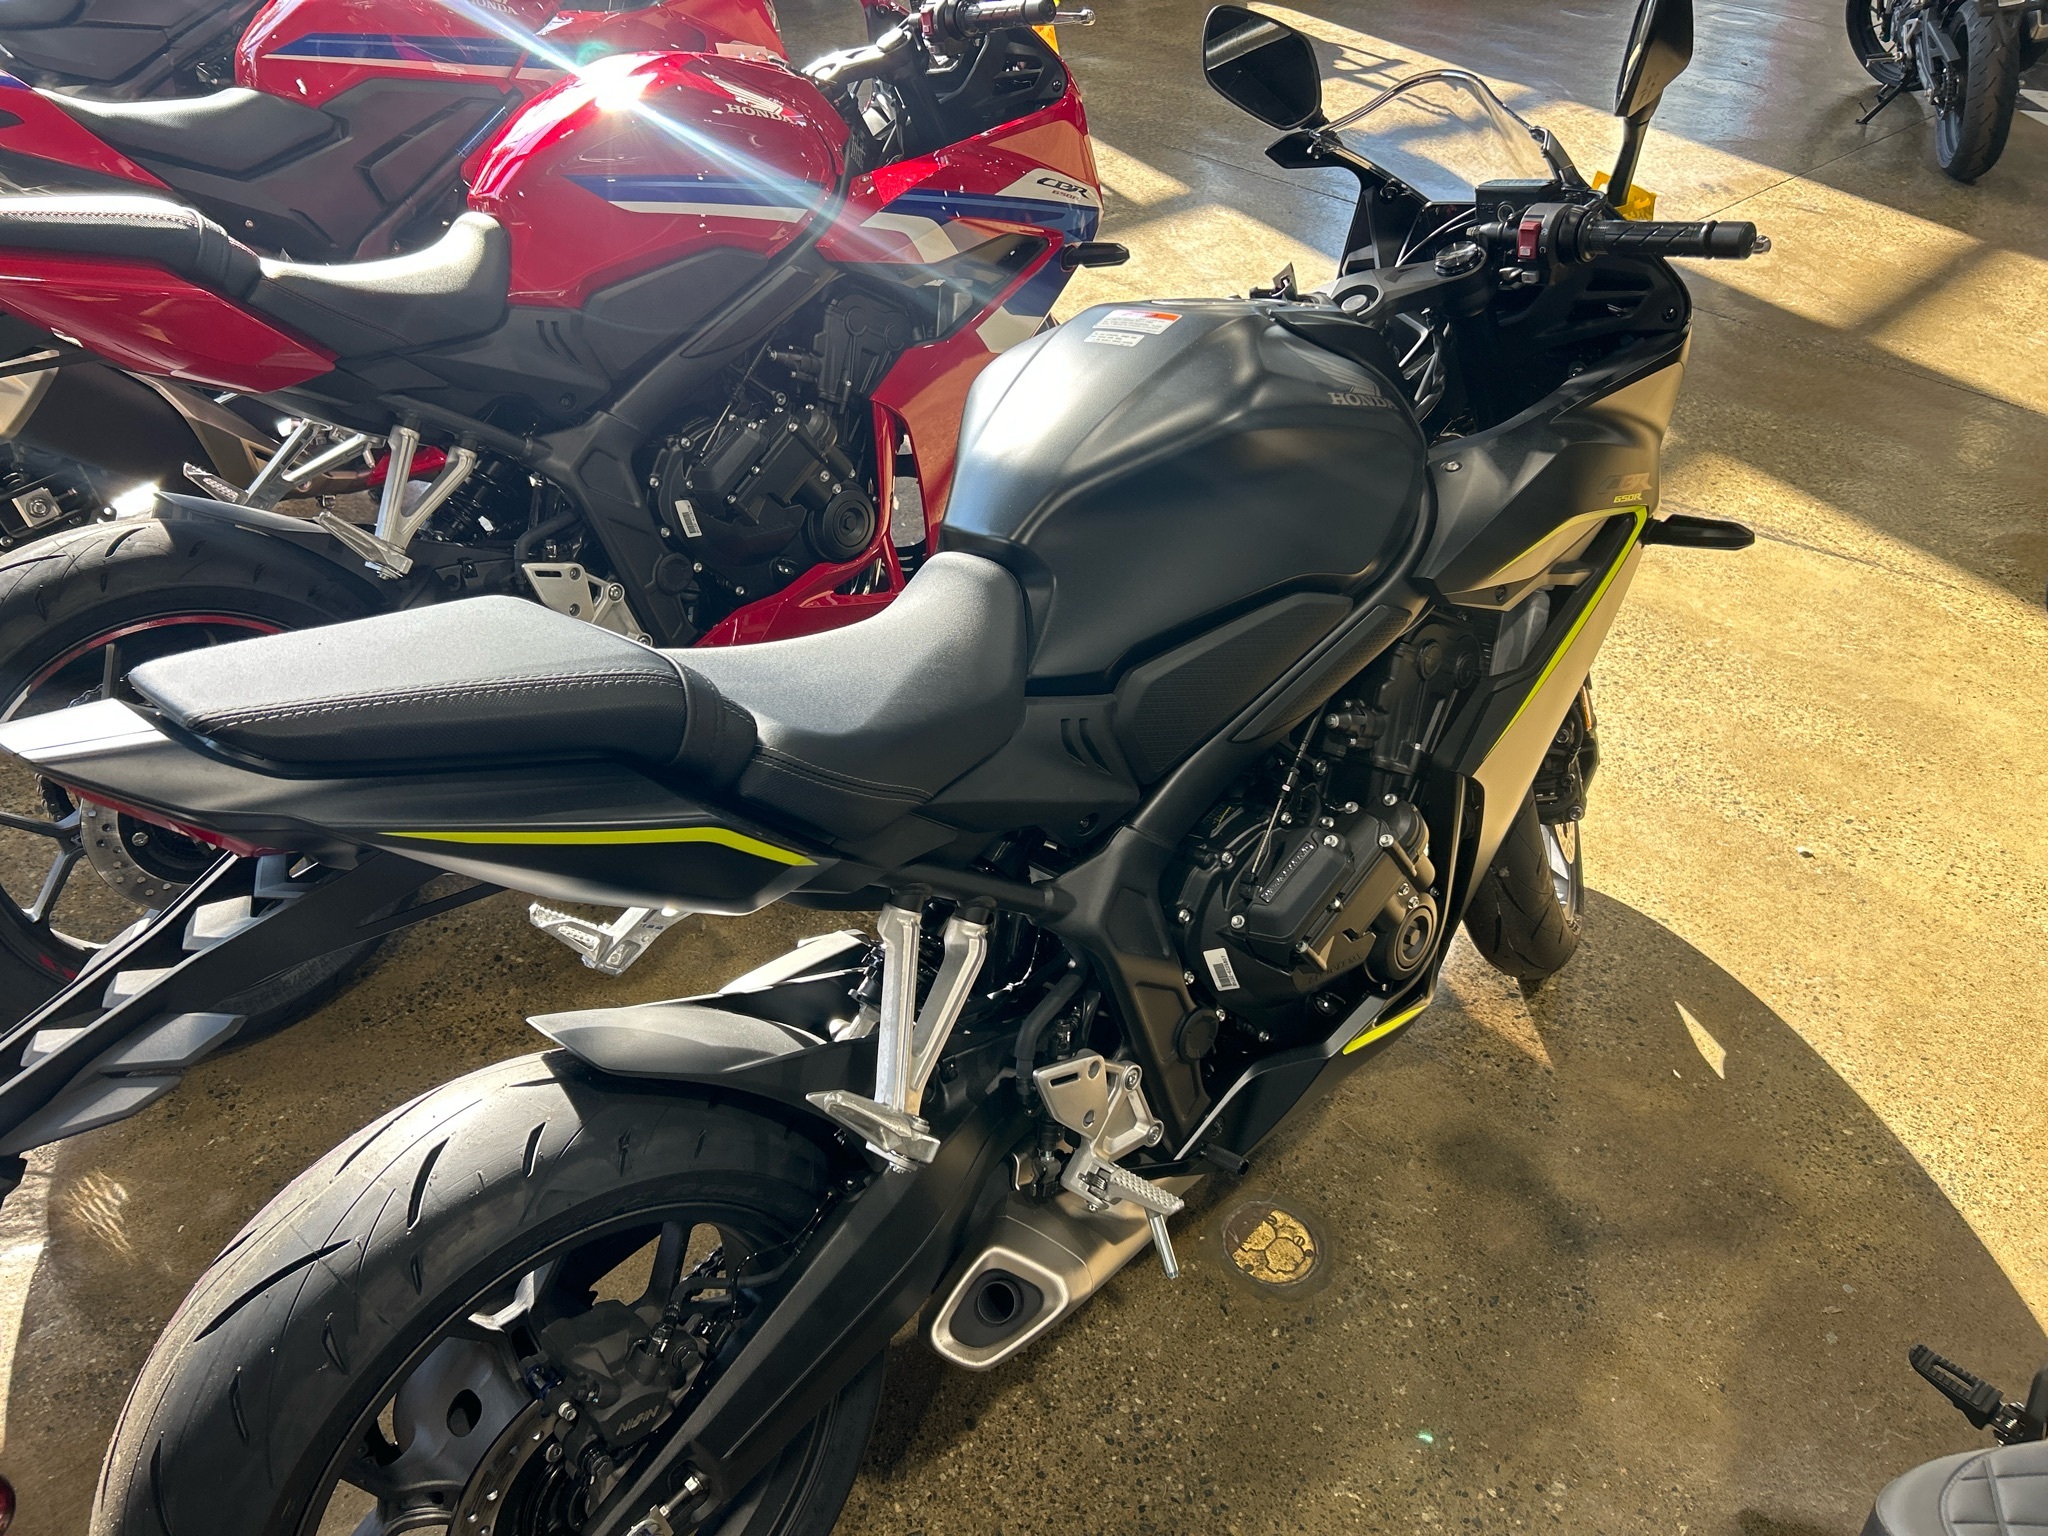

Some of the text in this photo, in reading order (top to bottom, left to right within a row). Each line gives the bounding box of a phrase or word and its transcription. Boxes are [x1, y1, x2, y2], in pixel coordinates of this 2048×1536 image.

[725, 103, 797, 125] HONDA
[1037, 177, 1090, 199] CBR
[1328, 392, 1400, 410] HONDA
[1613, 492, 1642, 503] 650R
